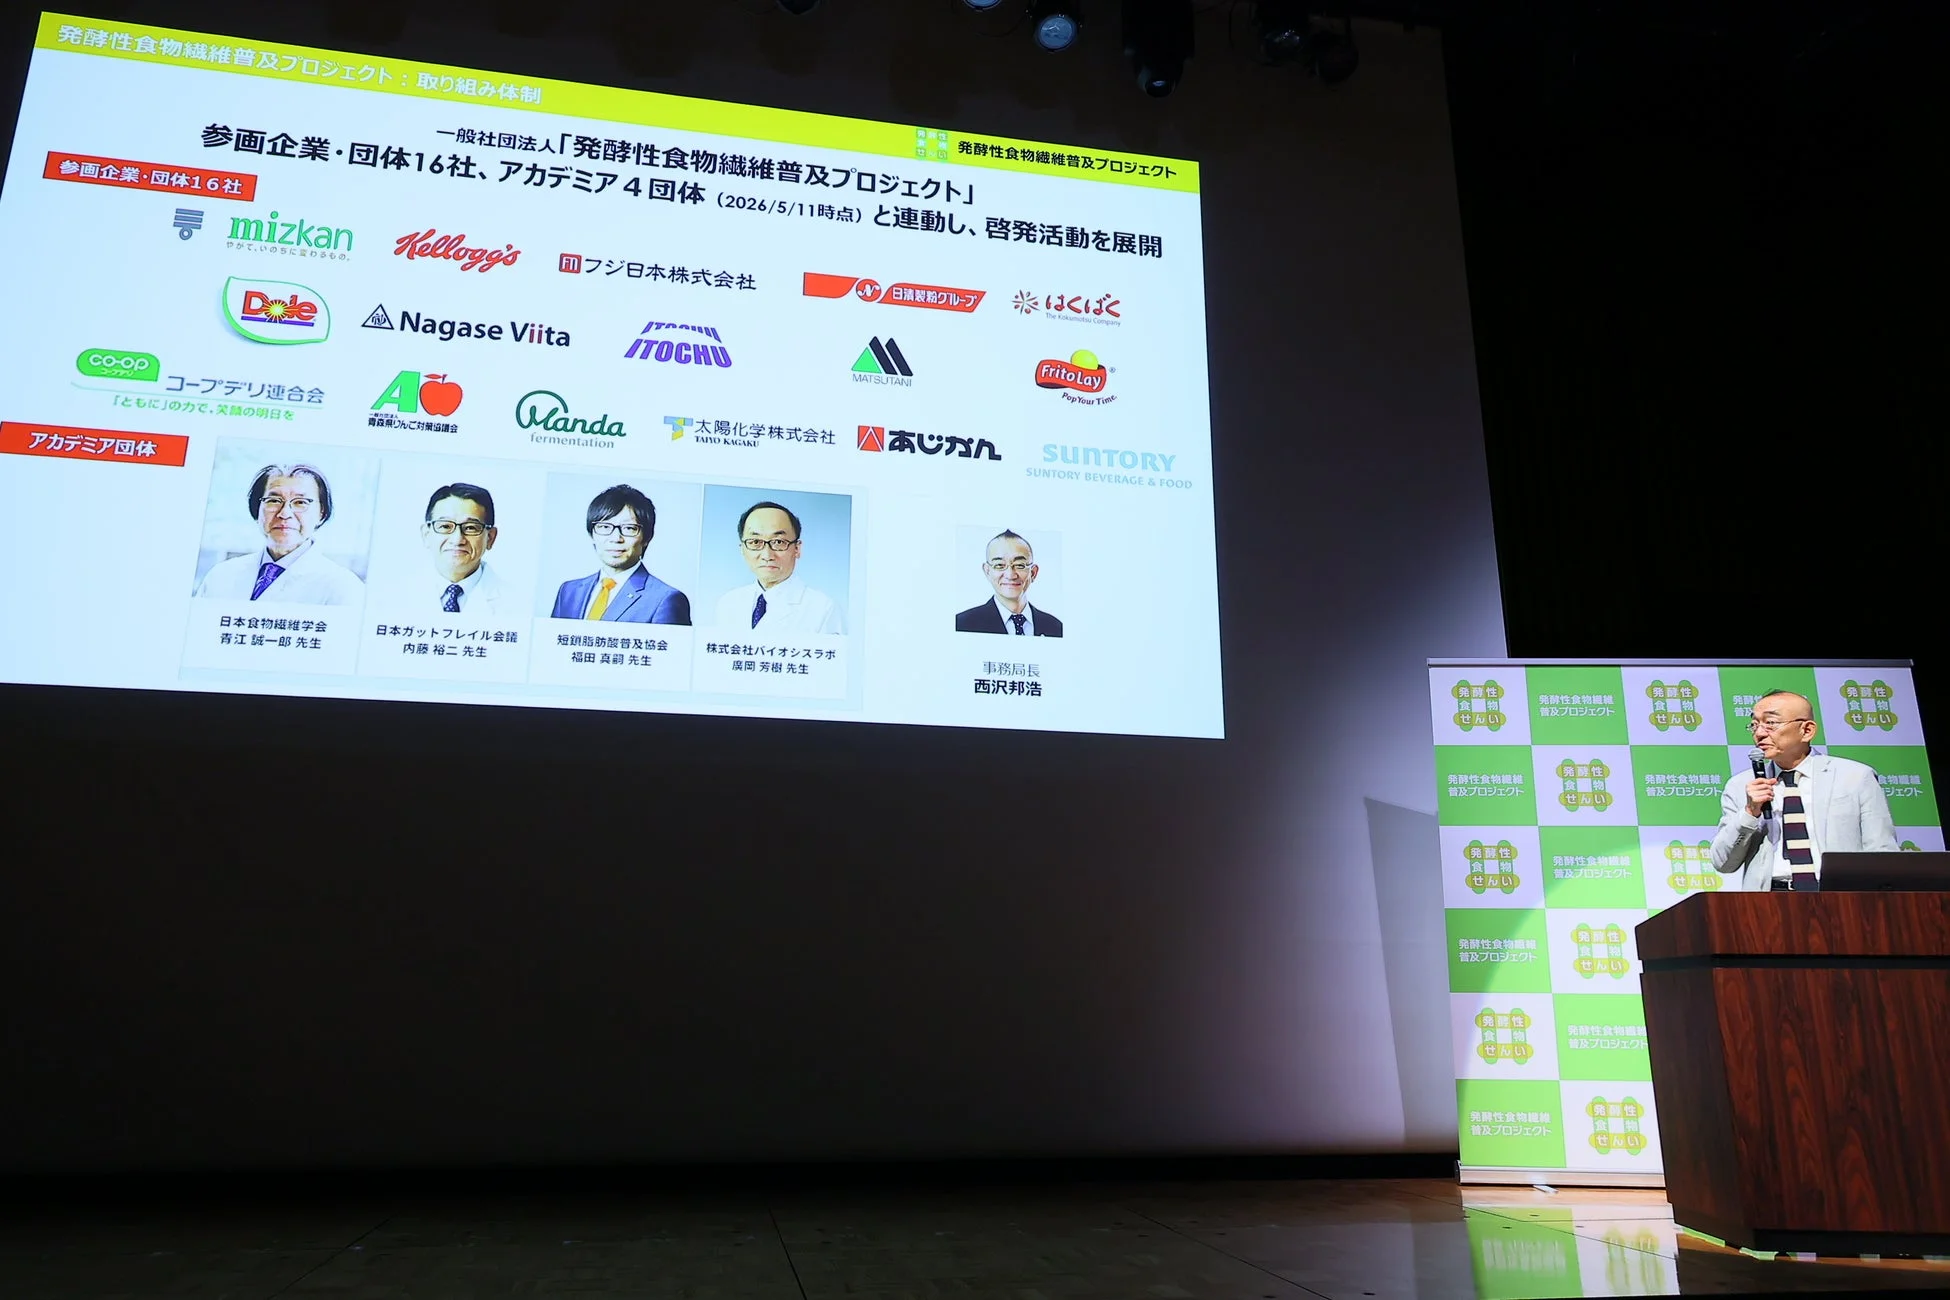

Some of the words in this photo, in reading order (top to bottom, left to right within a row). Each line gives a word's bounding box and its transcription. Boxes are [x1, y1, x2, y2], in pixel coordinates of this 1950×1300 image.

[958, 140, 1177, 178] 発酵性食物繊維普及プロジェクト
[437, 128, 974, 205] 一般社団法人「発酵性食物繊維普及プロジェクト」
[227, 211, 353, 251] mizkan
[394, 229, 521, 273] Kellogg's
[584, 258, 757, 290] フジ日本株式会社
[892, 286, 978, 308] 日清製粉グループ
[242, 290, 318, 321] Dole
[1045, 293, 1120, 318] はくばく
[1046, 312, 1056, 320] The
[1058, 314, 1092, 324] Kokumotsu
[1092, 318, 1121, 327] Company
[400, 311, 504, 342] Nagase
[510, 321, 570, 347] Viita
[624, 338, 733, 368] ITOCHU
[852, 373, 912, 388] MATSUTANI
[166, 376, 325, 404] コープデリ連合会
[368, 418, 458, 434] 青森県りんご対策協議会
[694, 419, 836, 445] 太陽化学株式会社
[29, 432, 158, 458] アカデミア団体
[530, 432, 614, 449] fermentation
[694, 436, 720, 444] TAIYO
[723, 438, 760, 448] KAGAKU
[888, 430, 1002, 460] あじかん
[1026, 468, 1080, 481] SUNTORY
[1084, 472, 1145, 486] BEVERAGE
[1148, 478, 1156, 487] &
[1160, 478, 1193, 490] FOOD
[220, 616, 327, 632] 日本食物繊維学会
[376, 624, 518, 643] 日本ガットフレイル会議
[220, 633, 246, 644] 青江
[250, 634, 292, 647] 誠一郎
[296, 637, 322, 649] 先生
[557, 634, 668, 651] 短鎖脂肪酸普及協会
[403, 643, 428, 654] 内藤
[433, 644, 458, 656] 裕二
[462, 646, 488, 658] 先生
[706, 642, 836, 660] 株式会社バイオシスラボ
[572, 652, 596, 663] 福田
[628, 654, 652, 666] 先生
[760, 662, 782, 673] 芳樹
[786, 663, 809, 674] 先生
[983, 660, 1040, 678] 事務局長
[974, 679, 1042, 697] 西沢邦浩
[1458, 687, 1498, 698] 発酵性
[1652, 687, 1692, 698] 発酵性
[1847, 686, 1887, 698] 発酵性
[1539, 694, 1614, 705] 発酵性食物繊維
[1540, 707, 1615, 717] 普及プロジェクト
[1460, 714, 1500, 725] せんい
[1656, 714, 1696, 725] せんい
[1851, 713, 1892, 724] せんい
[1563, 766, 1604, 778] 発酵性
[1448, 774, 1524, 785] 発酵性食物繊維
[1645, 774, 1721, 784] 発酵性食物繊維
[1878, 774, 1922, 784] 食物繊維
[1448, 786, 1524, 797] 普及プロジェクト
[1646, 786, 1722, 797] 普及プロジェクト
[1565, 793, 1607, 805] せんい
[1470, 847, 1511, 859] 発酵性
[1553, 856, 1630, 866] 発酵性食物繊維
[1554, 868, 1632, 879] 普及プロジェクト
[1472, 875, 1513, 887] せんい
[1674, 876, 1716, 887] せんい
[1578, 931, 1620, 943] 発酵性
[1458, 939, 1536, 950] 発酵性食物繊維
[1459, 952, 1538, 962] 普及プロジェクト
[1580, 959, 1623, 971] せんい
[1482, 1016, 1524, 1028] 発酵性
[1568, 1025, 1647, 1036] 発酵性食物繊維
[1568, 1038, 1648, 1049] 普及プロジェクト
[1484, 1044, 1526, 1056] せんい
[1594, 1104, 1636, 1116] 発酵性
[1470, 1112, 1551, 1123] 発酵性食物繊維
[1471, 1125, 1552, 1136] 普及プロジェクト
[1596, 1134, 1640, 1146] せんい
